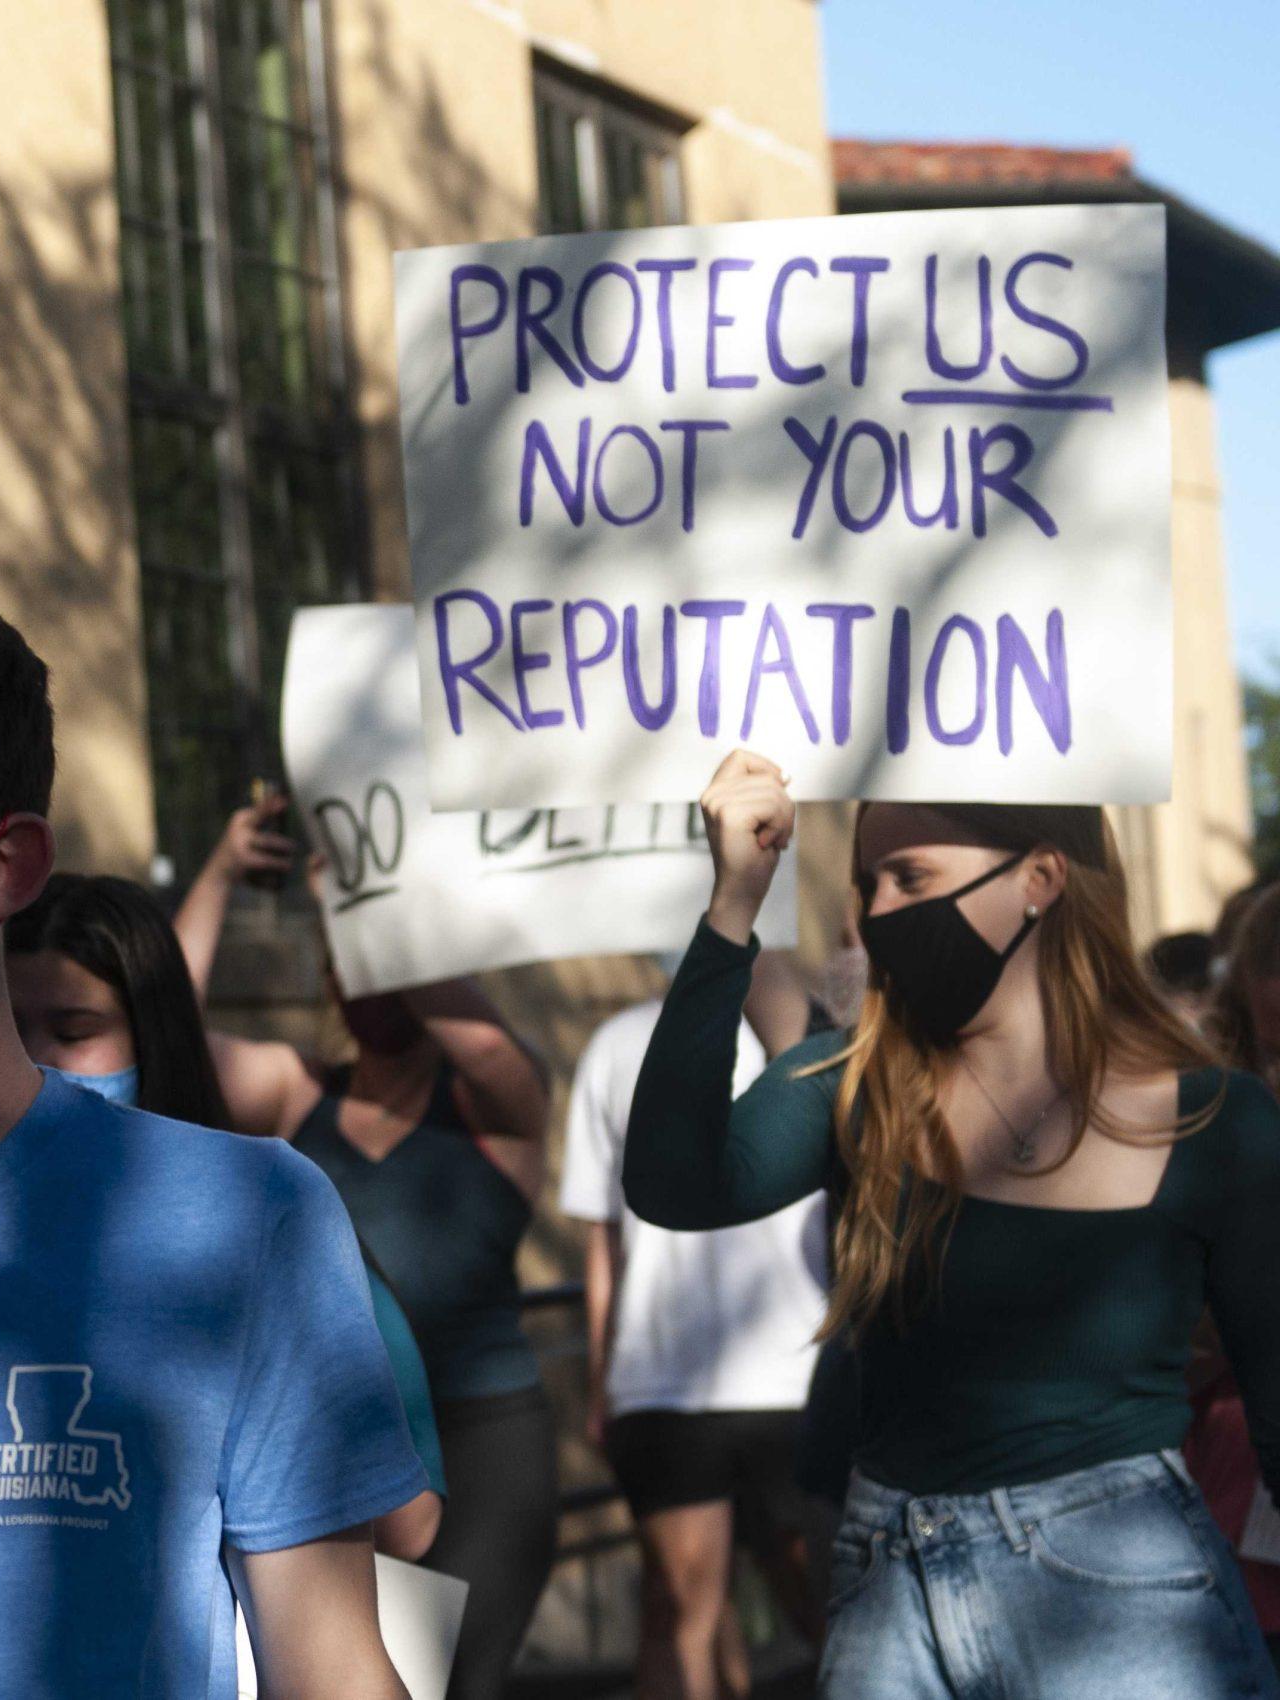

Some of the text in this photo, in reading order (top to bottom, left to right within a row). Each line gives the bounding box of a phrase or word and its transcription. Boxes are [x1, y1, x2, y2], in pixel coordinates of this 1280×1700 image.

[450, 251, 1090, 405] PROTECT US
[519, 415, 1058, 538] NOT YOUR
[433, 588, 1073, 757] REPUTATION
[314, 779, 405, 893] DO
